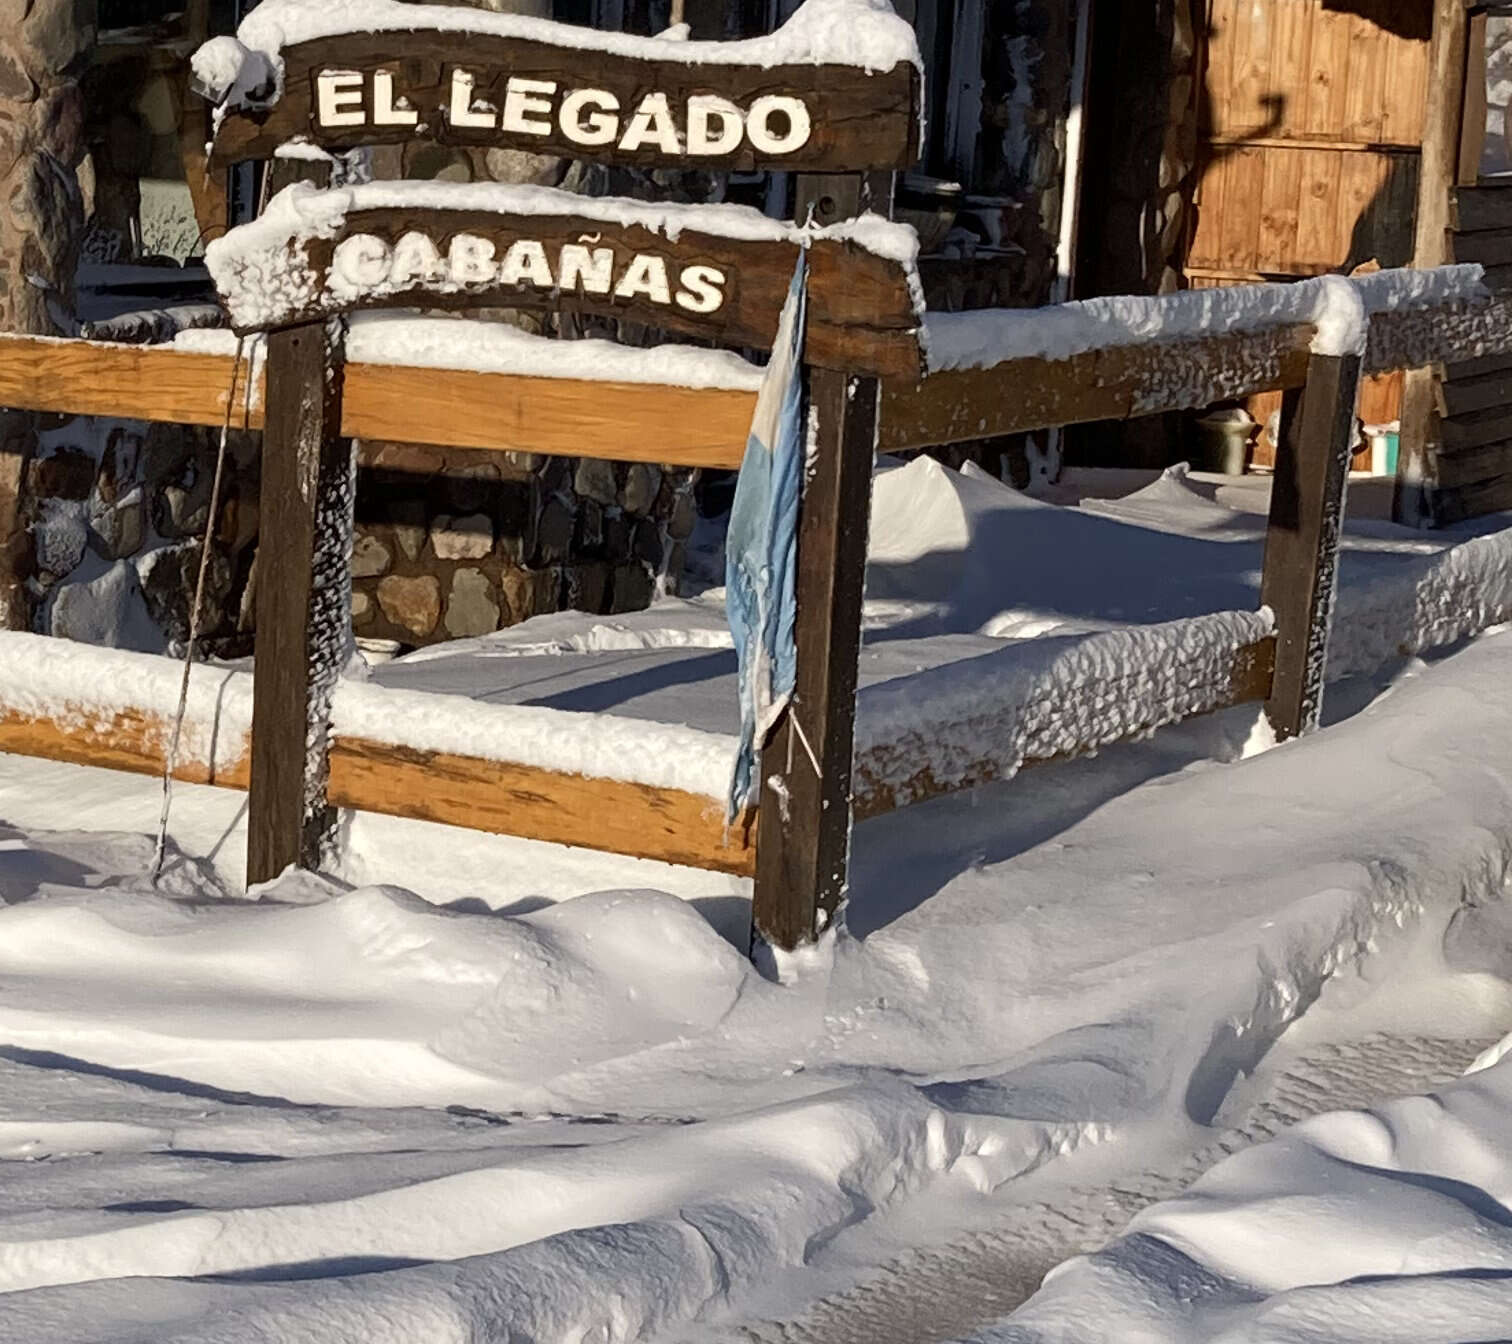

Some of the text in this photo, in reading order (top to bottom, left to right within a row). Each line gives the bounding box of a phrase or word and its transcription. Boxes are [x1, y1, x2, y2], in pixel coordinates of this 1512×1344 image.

[317, 68, 811, 156] EL LEGADO
[328, 231, 726, 313] CABAÑAS
